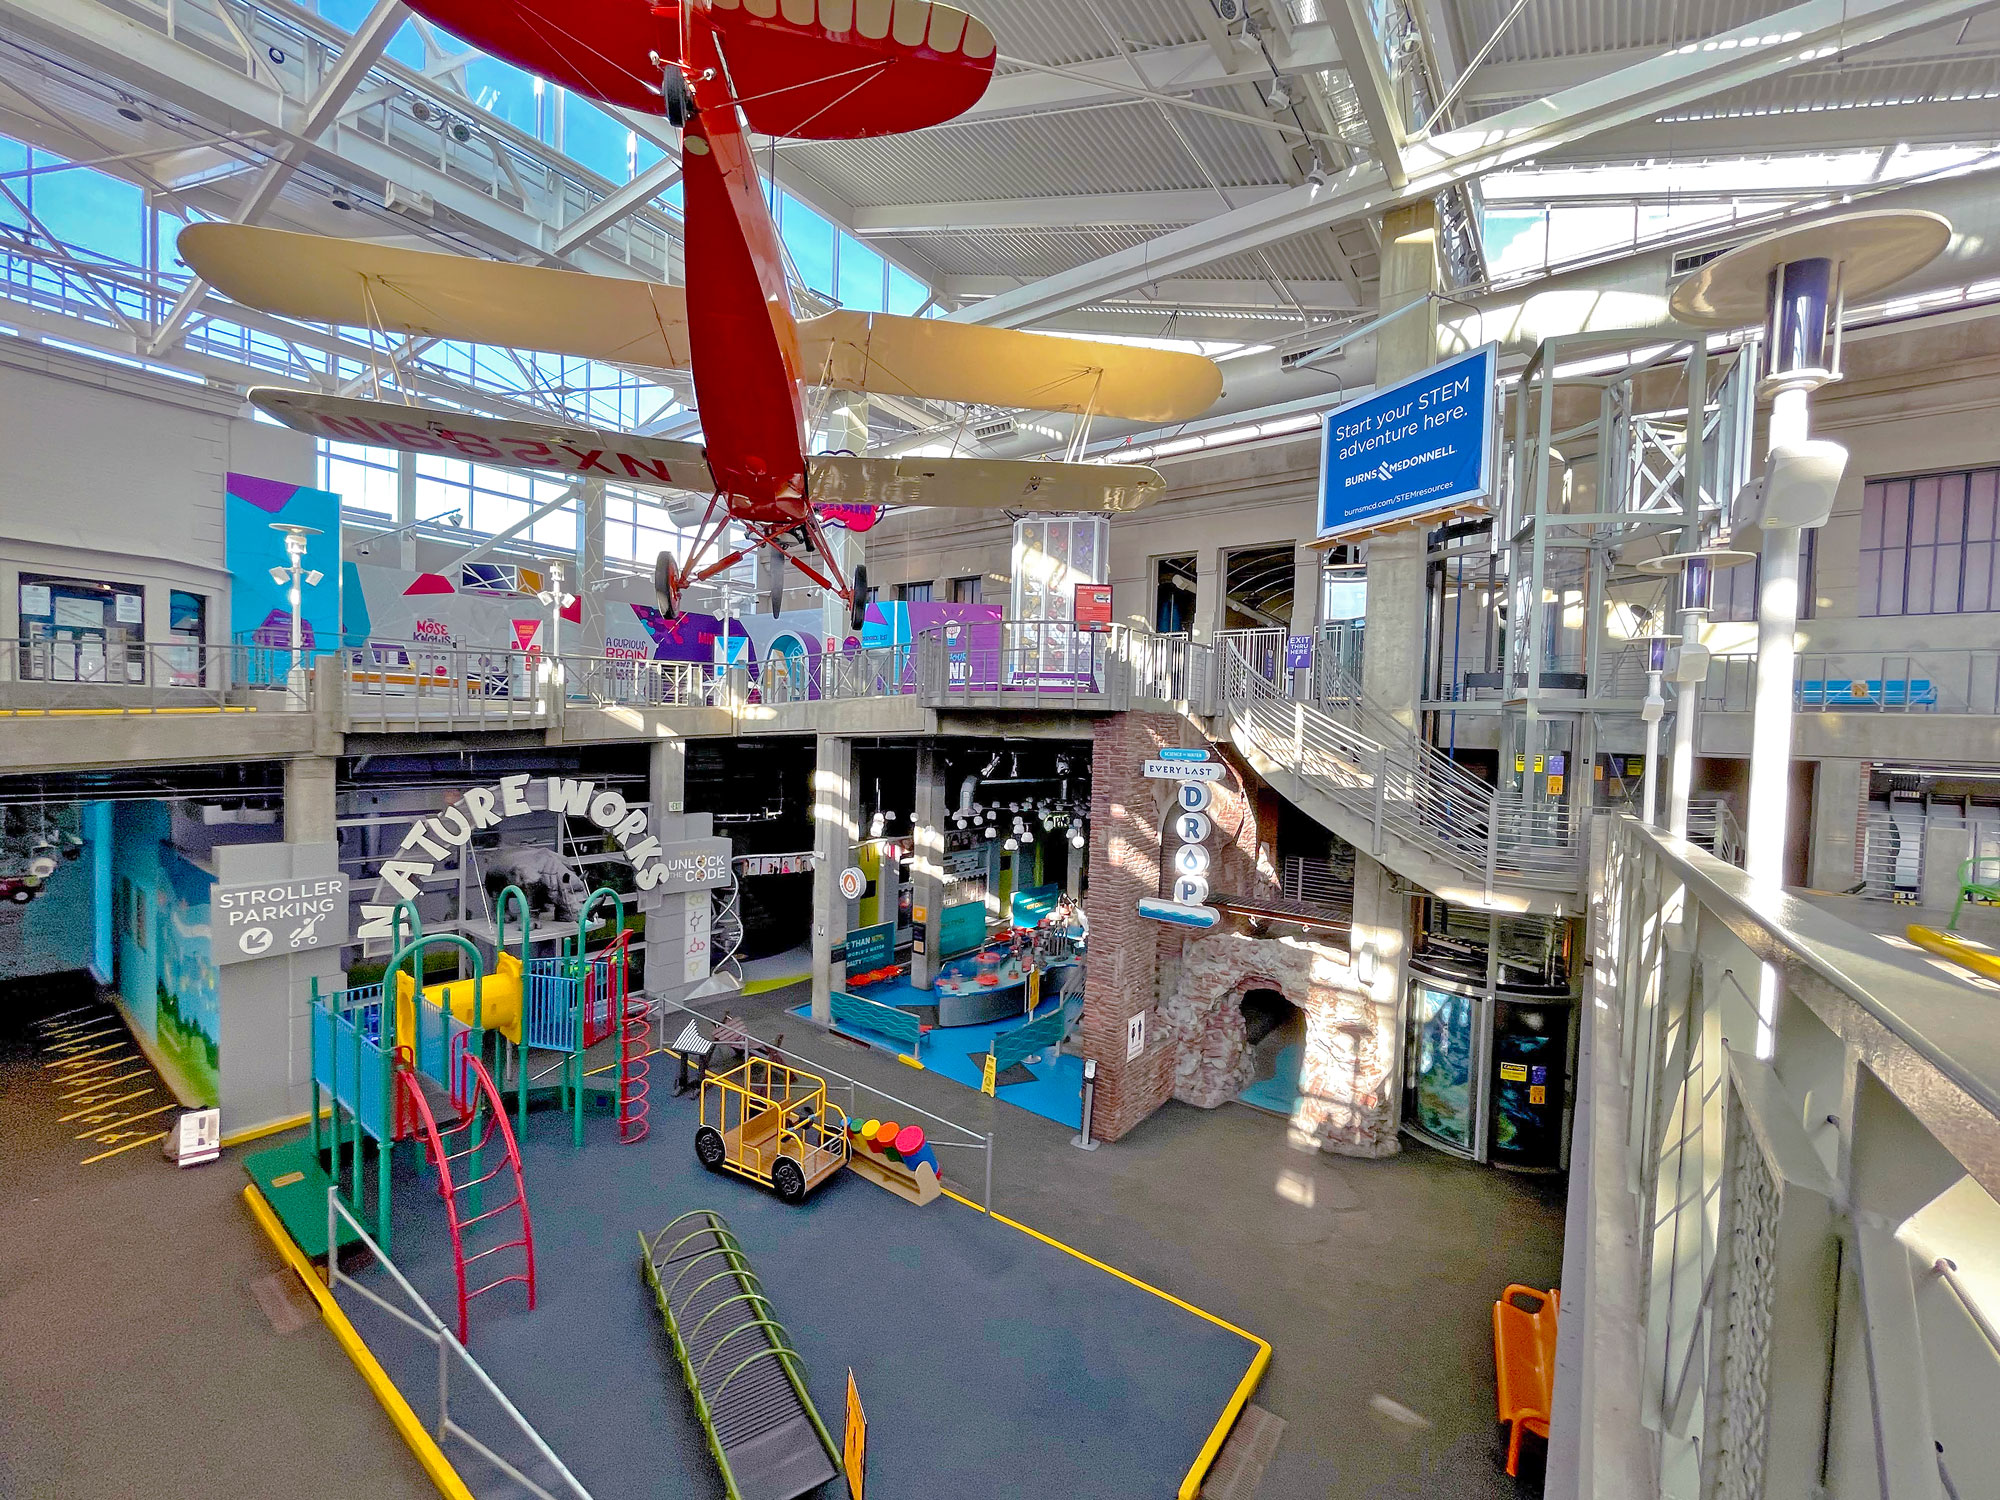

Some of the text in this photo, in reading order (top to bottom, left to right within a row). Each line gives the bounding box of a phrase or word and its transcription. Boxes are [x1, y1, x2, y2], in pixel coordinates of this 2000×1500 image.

[1335, 376, 1470, 442] Start your STEM
[1339, 405, 1468, 460] adventure here.
[1345, 469, 1377, 488] BURNS
[1344, 481, 1454, 517] burnsmcd.com/STEMresources
[416, 619, 449, 636] NOSE
[605, 637, 646, 651] A CURIOUS
[1290, 636, 1310, 644] EXIT
[605, 646, 648, 660] BRAIN
[1149, 764, 1212, 776] EVERY LAST
[357, 773, 670, 939] NATURE WORKS
[668, 855, 725, 871] UNLOCK
[685, 866, 726, 882] CODE
[219, 880, 343, 909] STROLLER
[229, 898, 334, 926] PARKING
